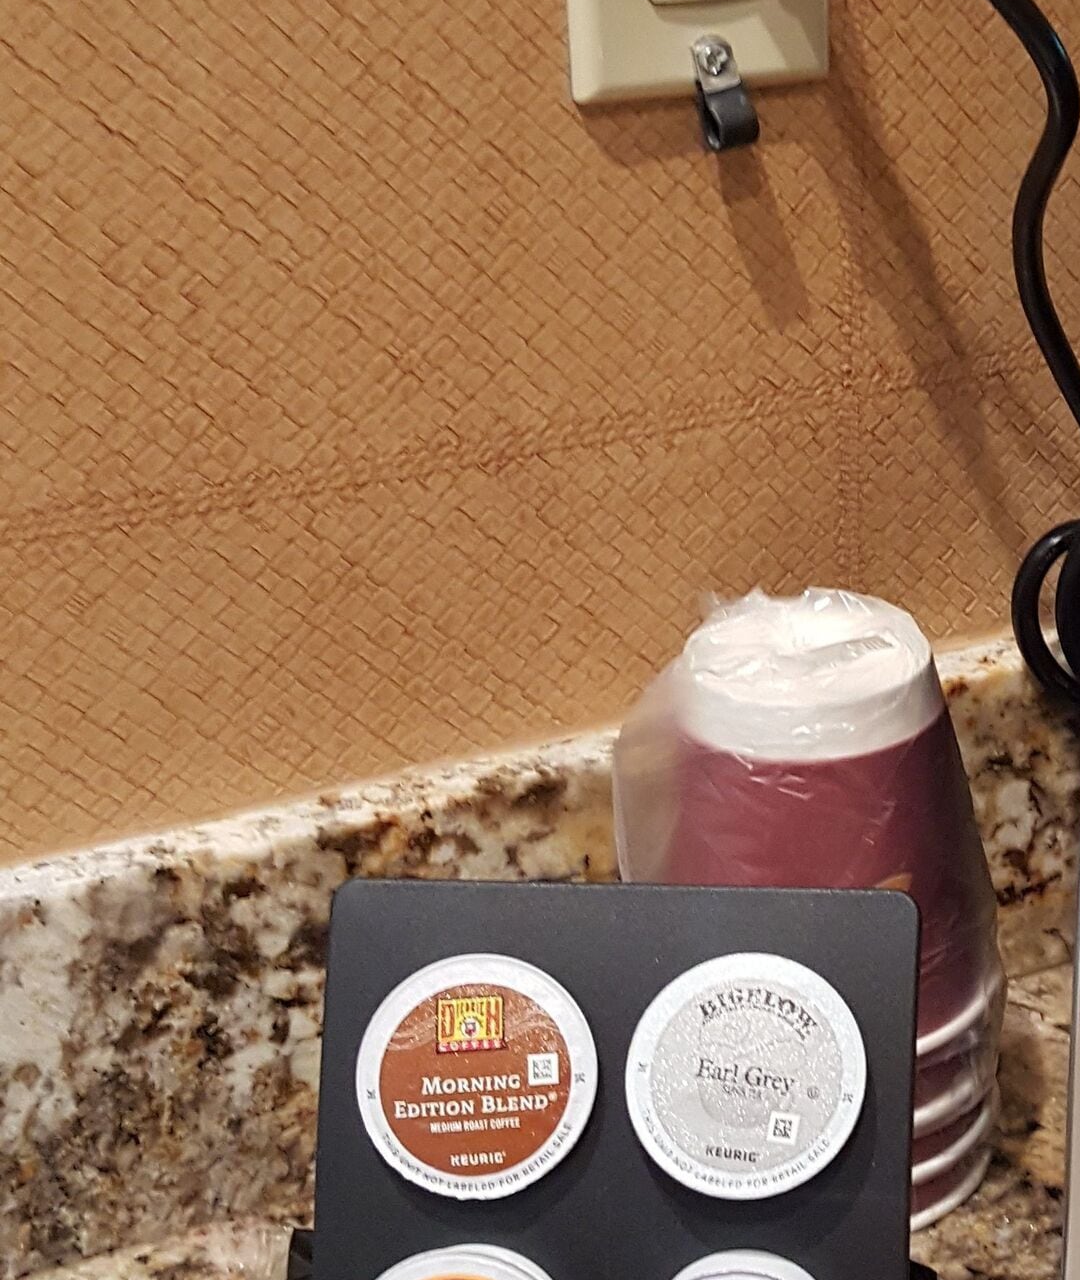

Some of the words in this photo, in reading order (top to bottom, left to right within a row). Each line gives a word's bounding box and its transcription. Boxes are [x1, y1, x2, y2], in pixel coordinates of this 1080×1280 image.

[698, 987, 817, 1036] BIGELOW
[421, 1074, 521, 1096] MORNING
[696, 1058, 739, 1083] Earl
[744, 1066, 795, 1096] Grey
[393, 1099, 475, 1119] EDITION
[430, 1121, 462, 1134] MEDIUM
[464, 1119, 489, 1132] ROAST
[490, 1116, 520, 1130] COFFEE
[451, 1152, 504, 1167] KEURIG
[706, 1145, 757, 1162] KEURIG
